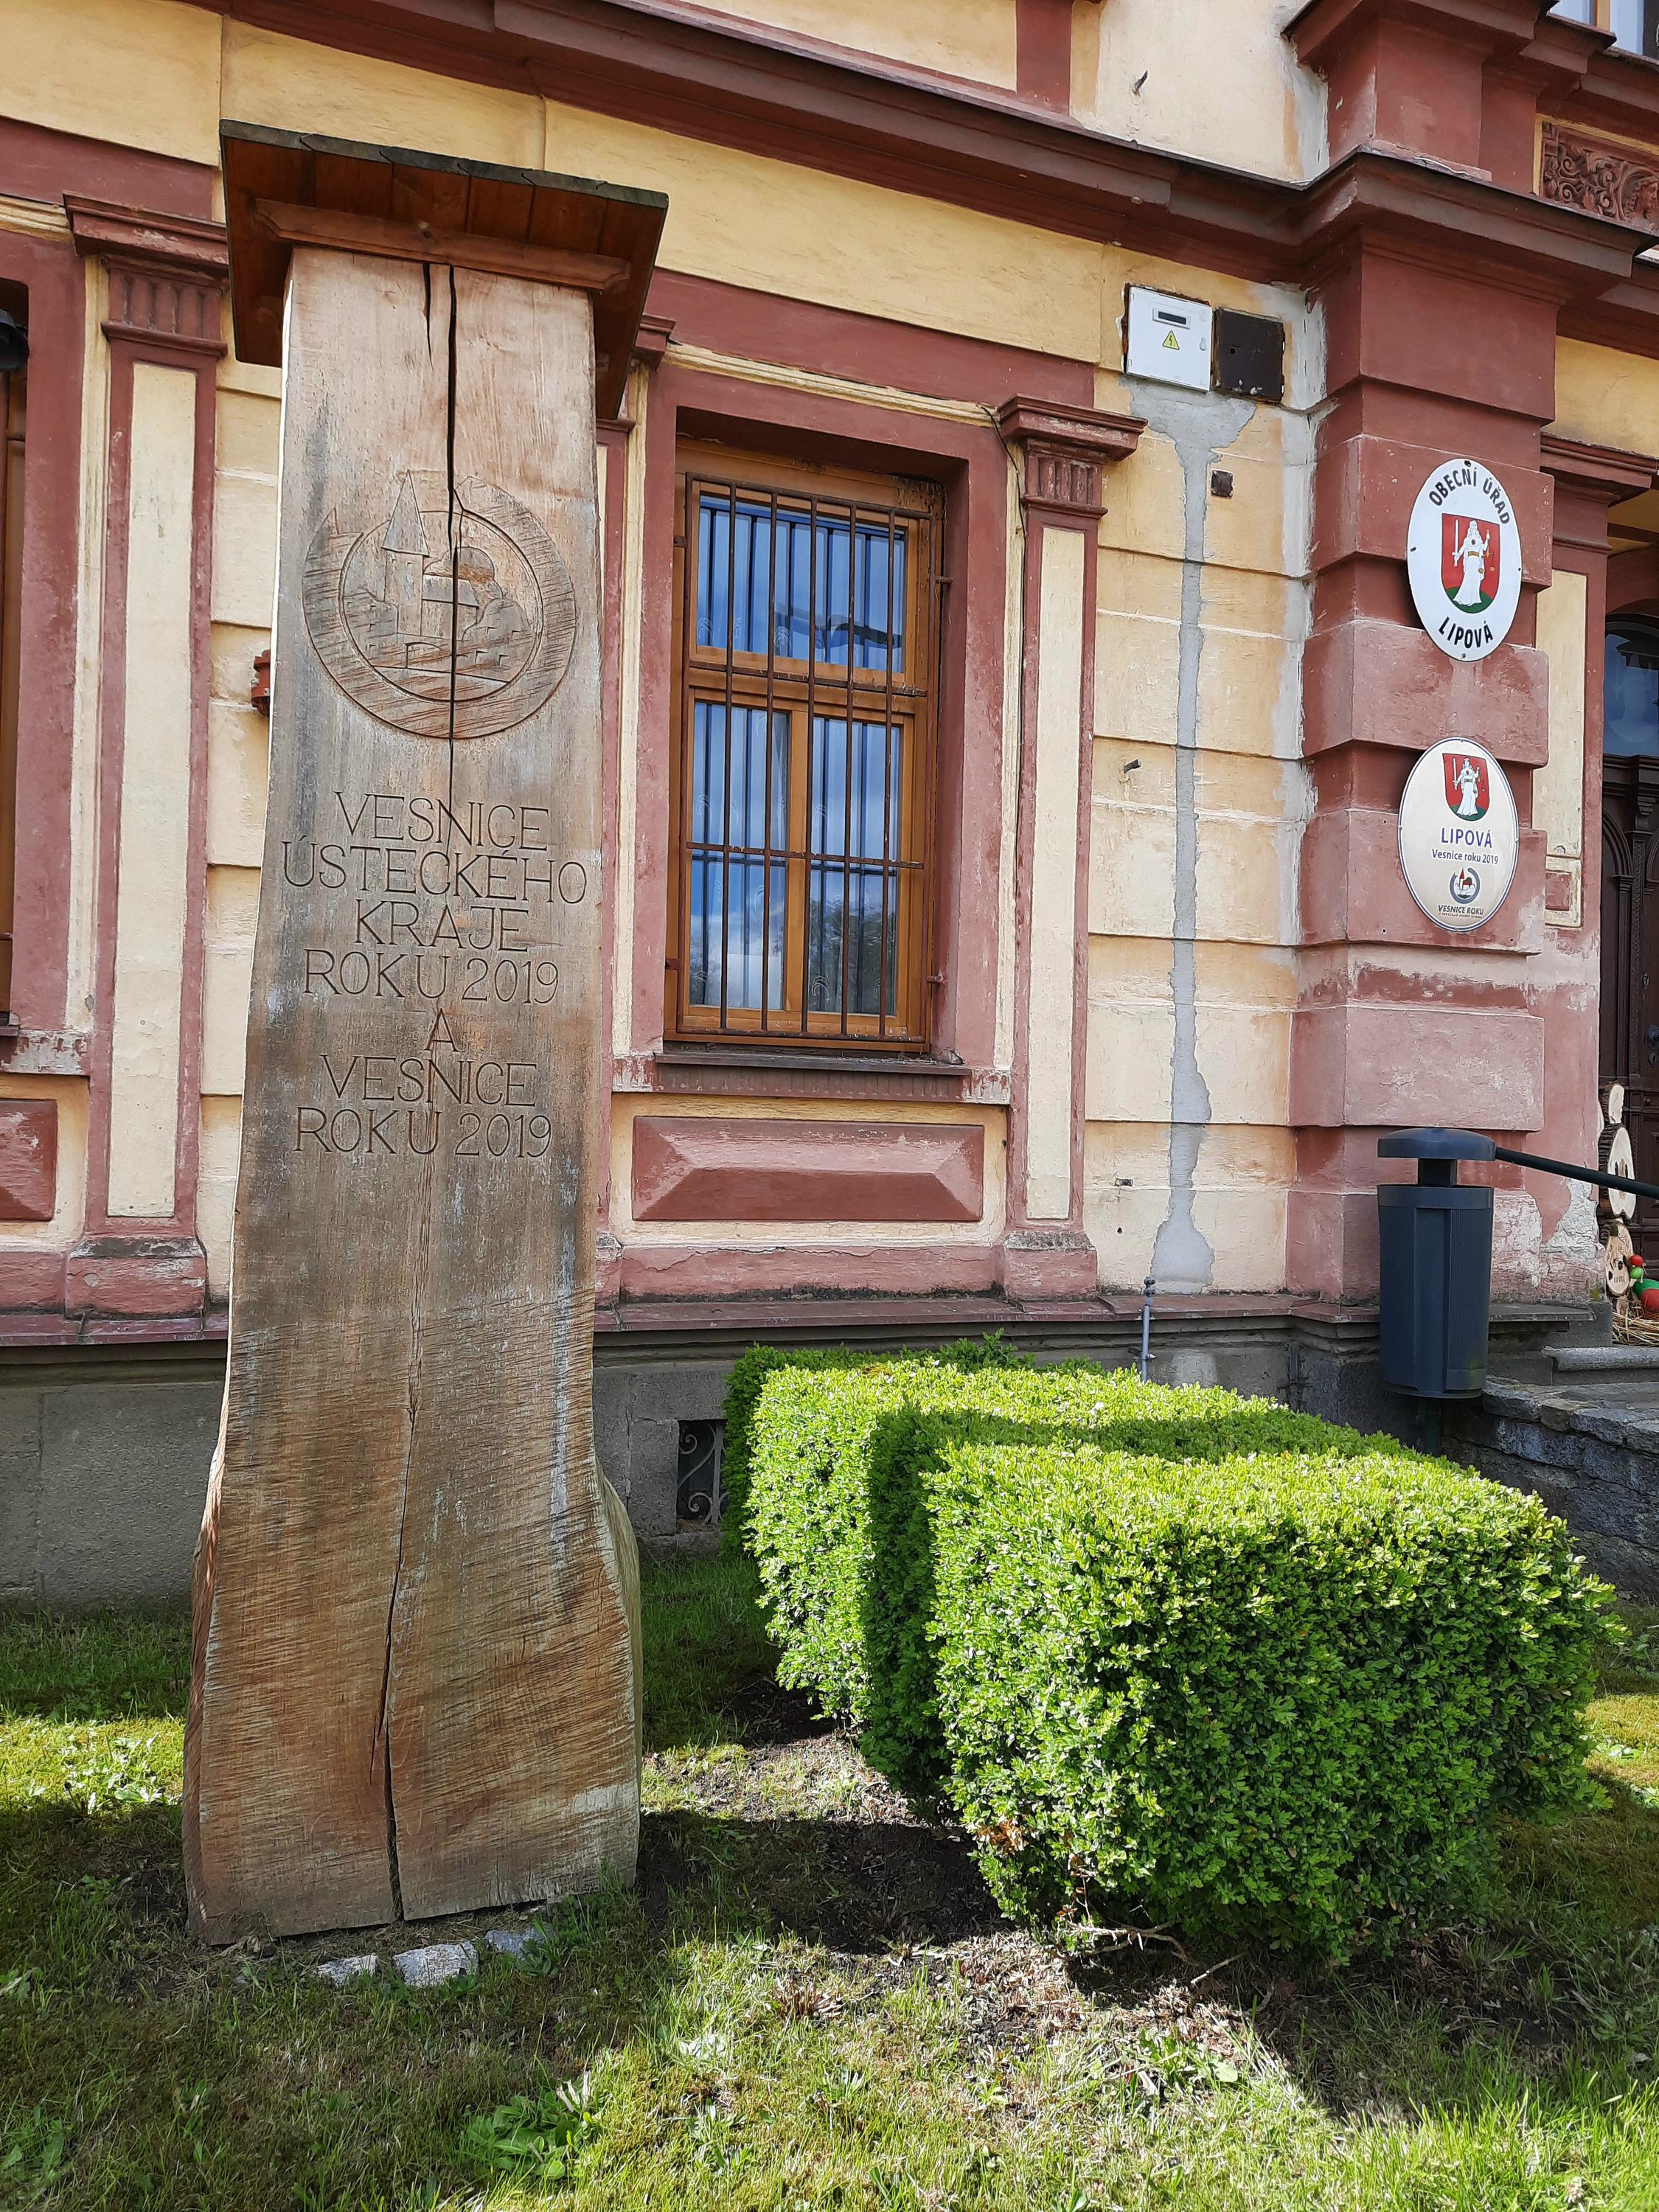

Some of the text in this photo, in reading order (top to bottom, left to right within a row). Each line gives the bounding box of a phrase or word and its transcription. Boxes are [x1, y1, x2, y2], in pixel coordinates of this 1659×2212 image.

[1428, 467, 1510, 525] OBECNÍ ÚŘAD
[1439, 616, 1494, 649] LIPOVÁ
[333, 791, 549, 852] VESNICE
[1441, 827, 1493, 849] LIPOVÁ
[280, 835, 588, 905] ÚSTECKÉHO
[1432, 849, 1498, 865] Vesnice roku 2019
[354, 899, 529, 953] KRAJE
[1438, 905, 1484, 915] VESNICE ROKU
[302, 948, 559, 1004] ROKU 2019
[423, 1007, 460, 1053] A
[319, 1054, 538, 1107] VESNICE
[294, 1107, 552, 1158] ROKU 2019
